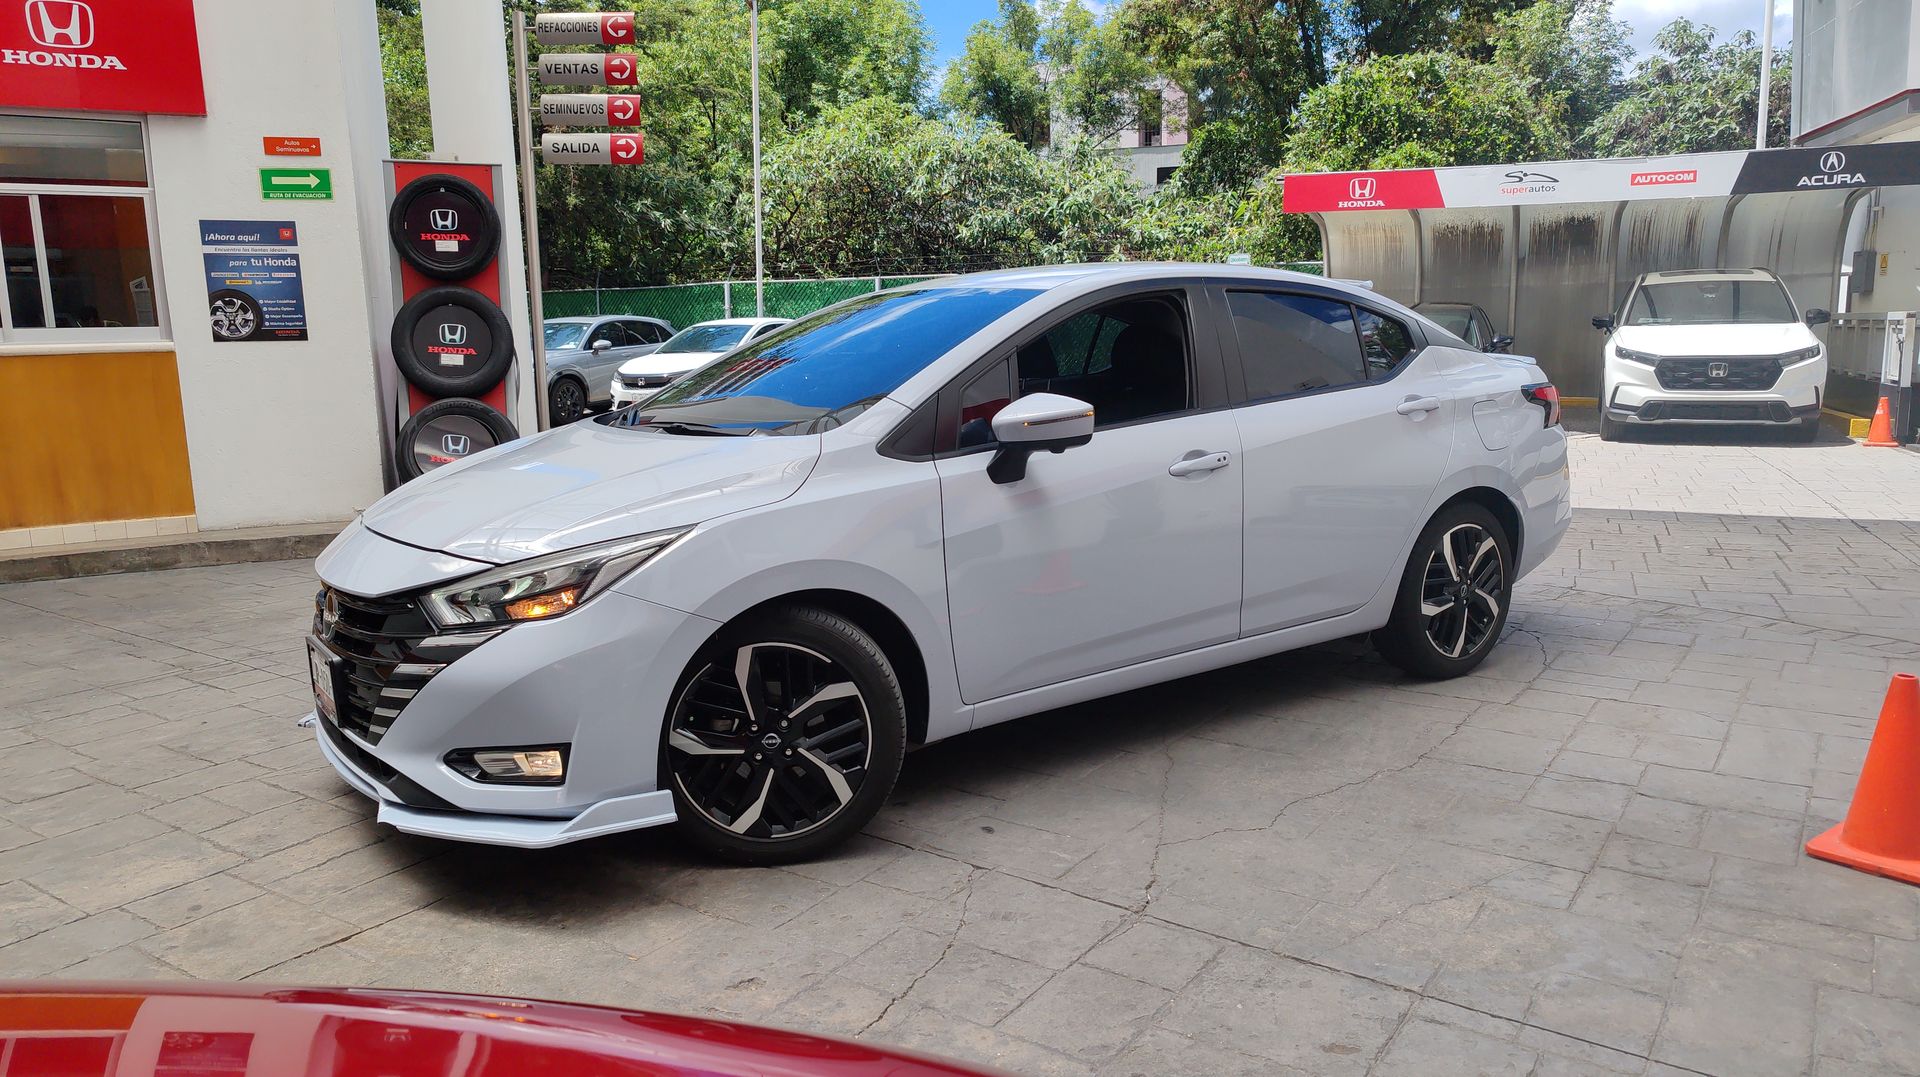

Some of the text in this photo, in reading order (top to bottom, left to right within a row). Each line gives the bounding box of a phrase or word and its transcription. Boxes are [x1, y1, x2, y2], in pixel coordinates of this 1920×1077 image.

[538, 21, 599, 33] REFACCIONES
[1, 49, 128, 71] HONDA
[545, 63, 599, 75] VENTAS
[543, 103, 604, 115] SEMINUEVOS
[552, 142, 600, 154] SALIDA
[1633, 172, 1695, 184] AUTOCOM
[1796, 172, 1867, 187] ACURA
[1501, 183, 1557, 195] superautos
[1337, 199, 1386, 208] HONDA
[205, 233, 260, 242] ¡Ahora aquí!
[420, 233, 471, 241] HONDA
[250, 258, 262, 266] tu
[264, 257, 297, 266] Honda
[427, 346, 478, 355] HONDA
